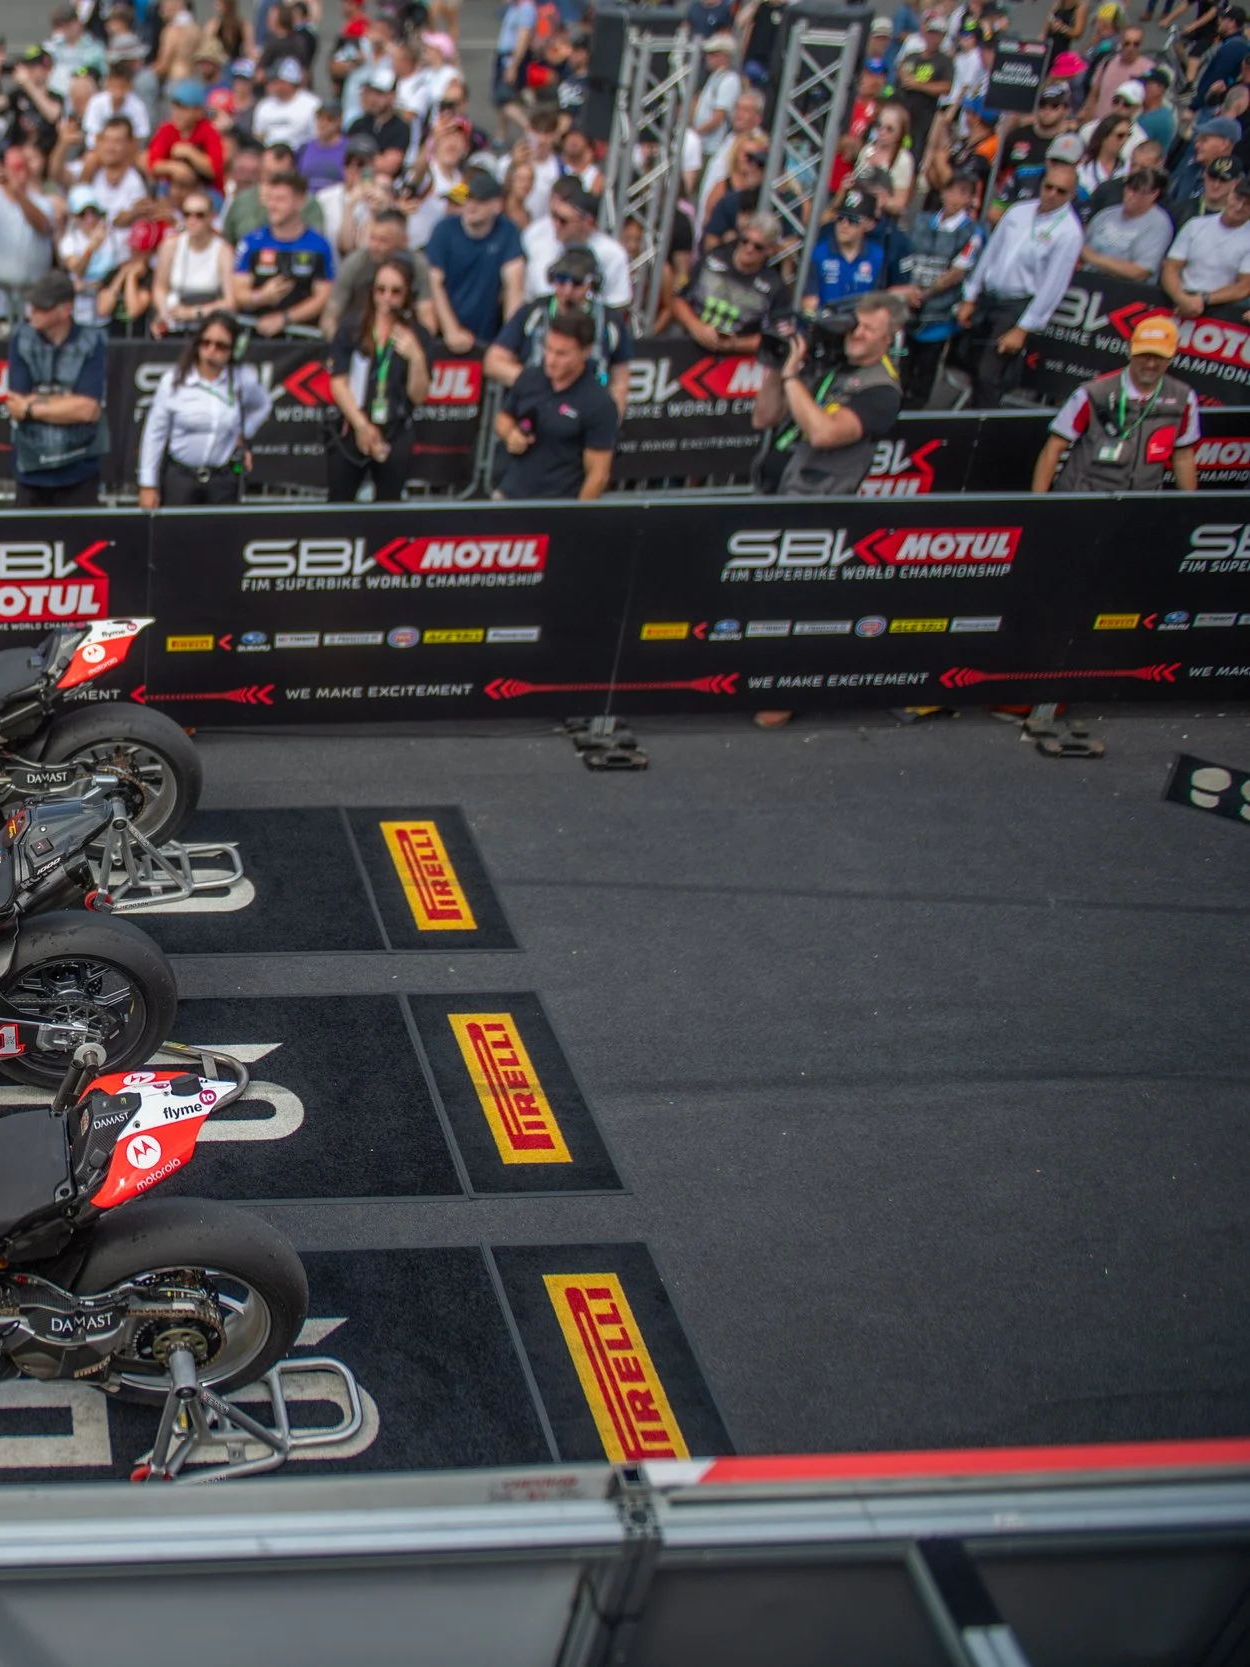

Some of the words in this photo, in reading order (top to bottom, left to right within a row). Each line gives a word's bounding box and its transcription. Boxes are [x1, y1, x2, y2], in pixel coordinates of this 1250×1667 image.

[1195, 442, 1250, 466] MOT
[242, 537, 410, 577] SBK
[419, 540, 542, 569] MOTUL
[725, 529, 890, 570] SBK
[897, 531, 1013, 561] MOTUL
[720, 568, 750, 583] FIM
[753, 567, 837, 582] SUPERBIKE
[841, 565, 896, 580] WORLD
[899, 562, 1012, 579] CHAMPIONSHIP
[1178, 560, 1206, 573] FIM
[241, 577, 271, 592] FIM
[275, 575, 362, 591] SUPERBIKE
[366, 574, 422, 589] WORLD
[426, 572, 544, 587] CHAMPIONSHIP
[11, 620, 42, 630] WORLD
[747, 675, 774, 689] WE
[777, 674, 825, 688] MAKE
[826, 671, 931, 688] EXCITEMENT
[1189, 666, 1213, 678] WE
[285, 688, 311, 699] WE
[315, 686, 362, 699] MAKE
[367, 683, 474, 698] EXCITEMENT
[26, 771, 68, 785] DAMAST
[36, 856, 62, 876] 1000
[396, 828, 463, 921] PIRELLI
[466, 1020, 556, 1151] PIRELLI
[162, 1101, 203, 1120] flyme
[201, 1092, 215, 1103] to
[92, 1110, 130, 1131] DAMAST
[136, 1157, 182, 1192] motorola
[51, 1311, 114, 1334] DAMAST
